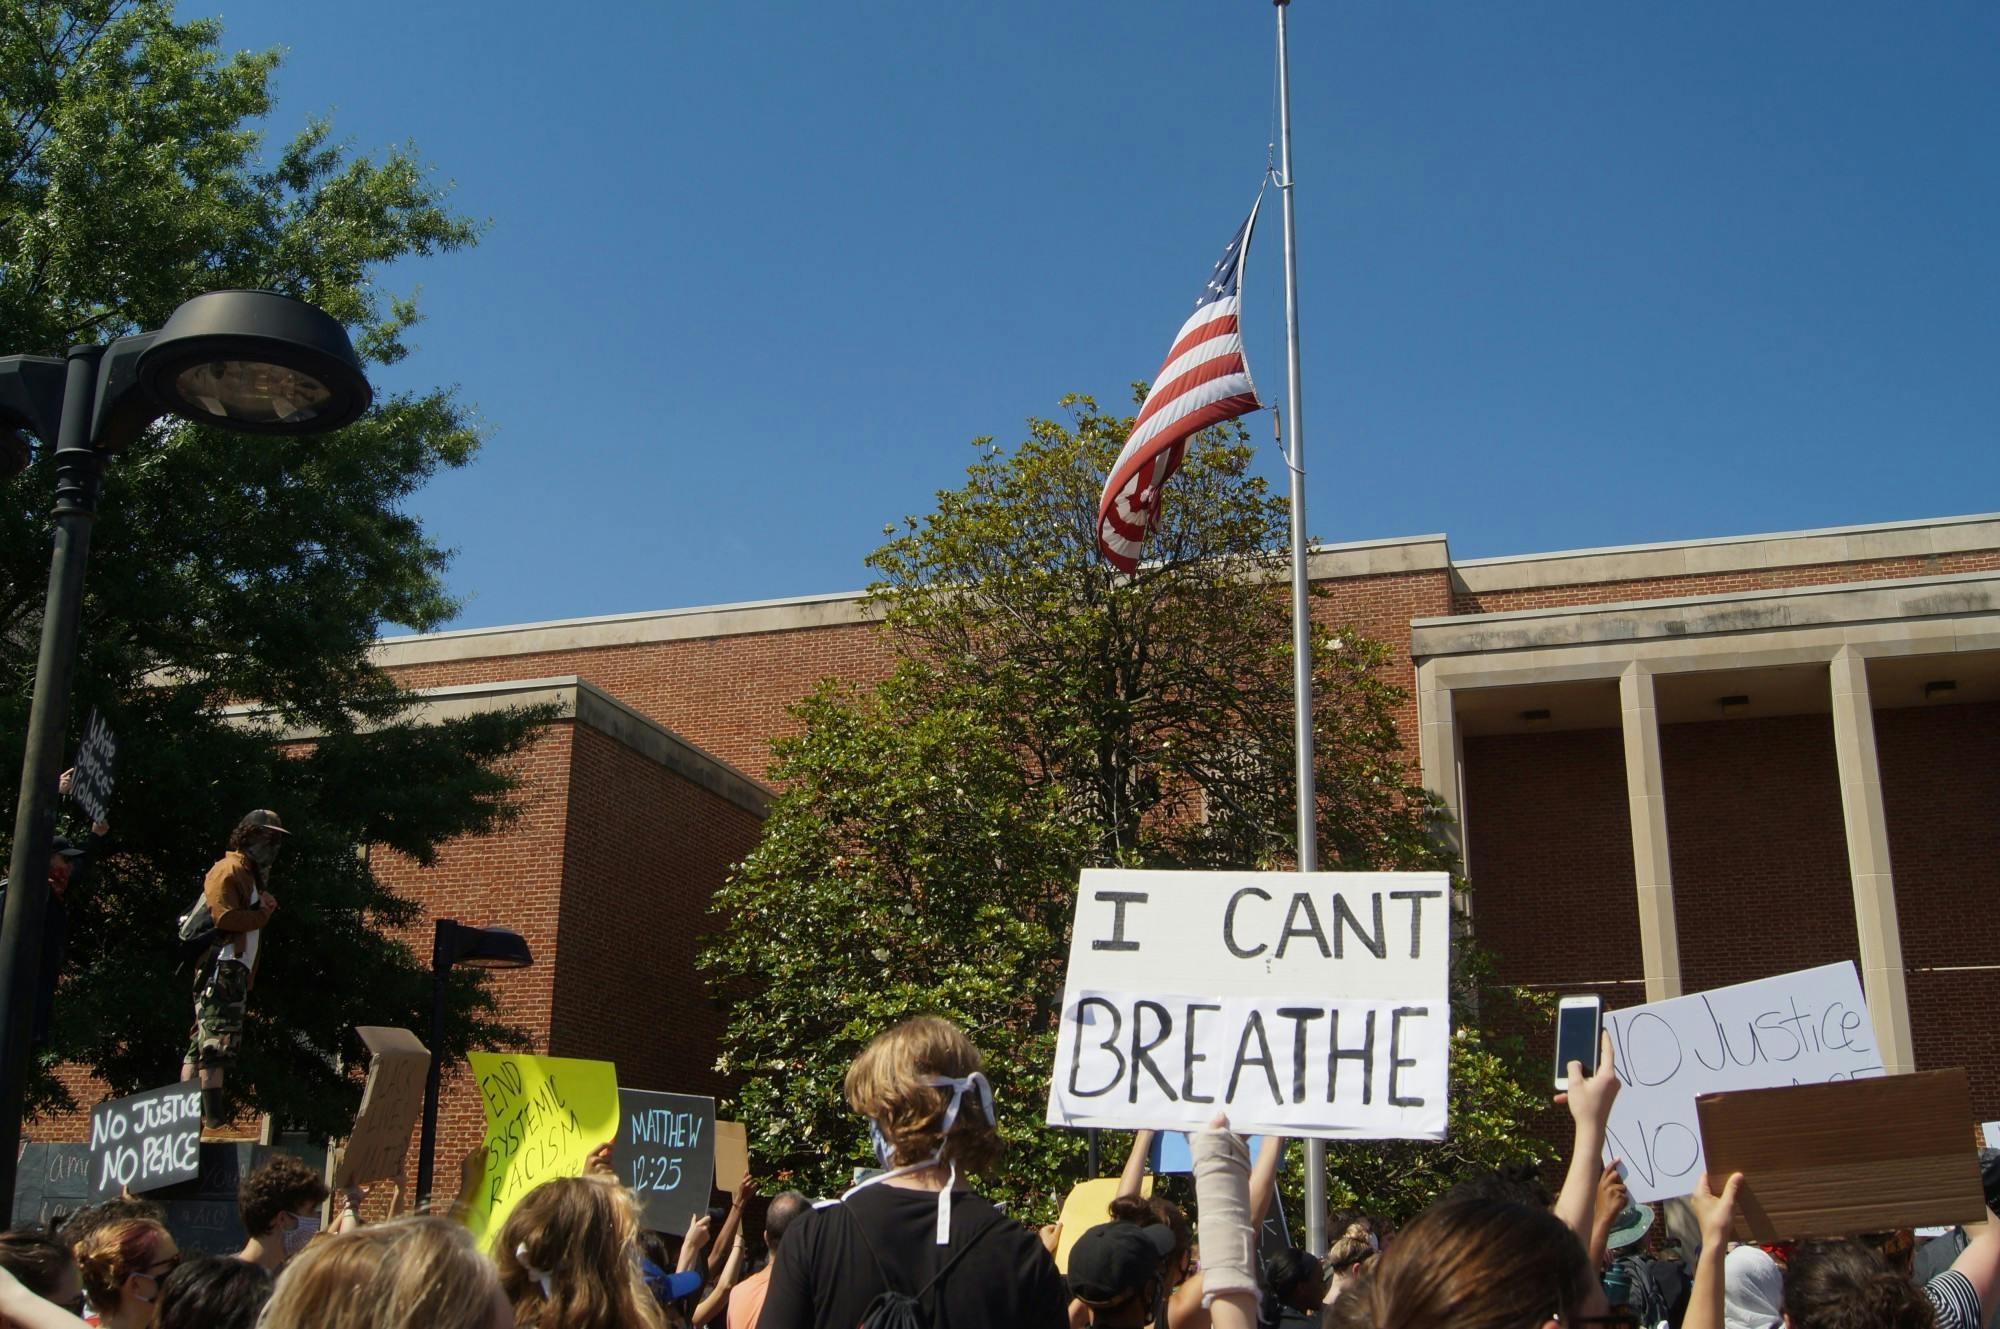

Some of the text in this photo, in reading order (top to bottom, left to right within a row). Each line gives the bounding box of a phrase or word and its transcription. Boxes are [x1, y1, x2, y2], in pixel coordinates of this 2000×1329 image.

[1092, 887, 1443, 960] I CANT
[1068, 996, 1429, 1107] BREATHE
[90, 1091, 202, 1151] NO JUSTICE
[483, 1061, 522, 1118] END
[488, 1074, 566, 1171] SYSTEMIC
[631, 1108, 703, 1148] MATTHEW
[1604, 1120, 1700, 1189] NO
[99, 1145, 139, 1191] NO
[142, 1131, 199, 1179] PEACE
[490, 1110, 582, 1214] RACISM
[633, 1155, 682, 1192] 12:25
